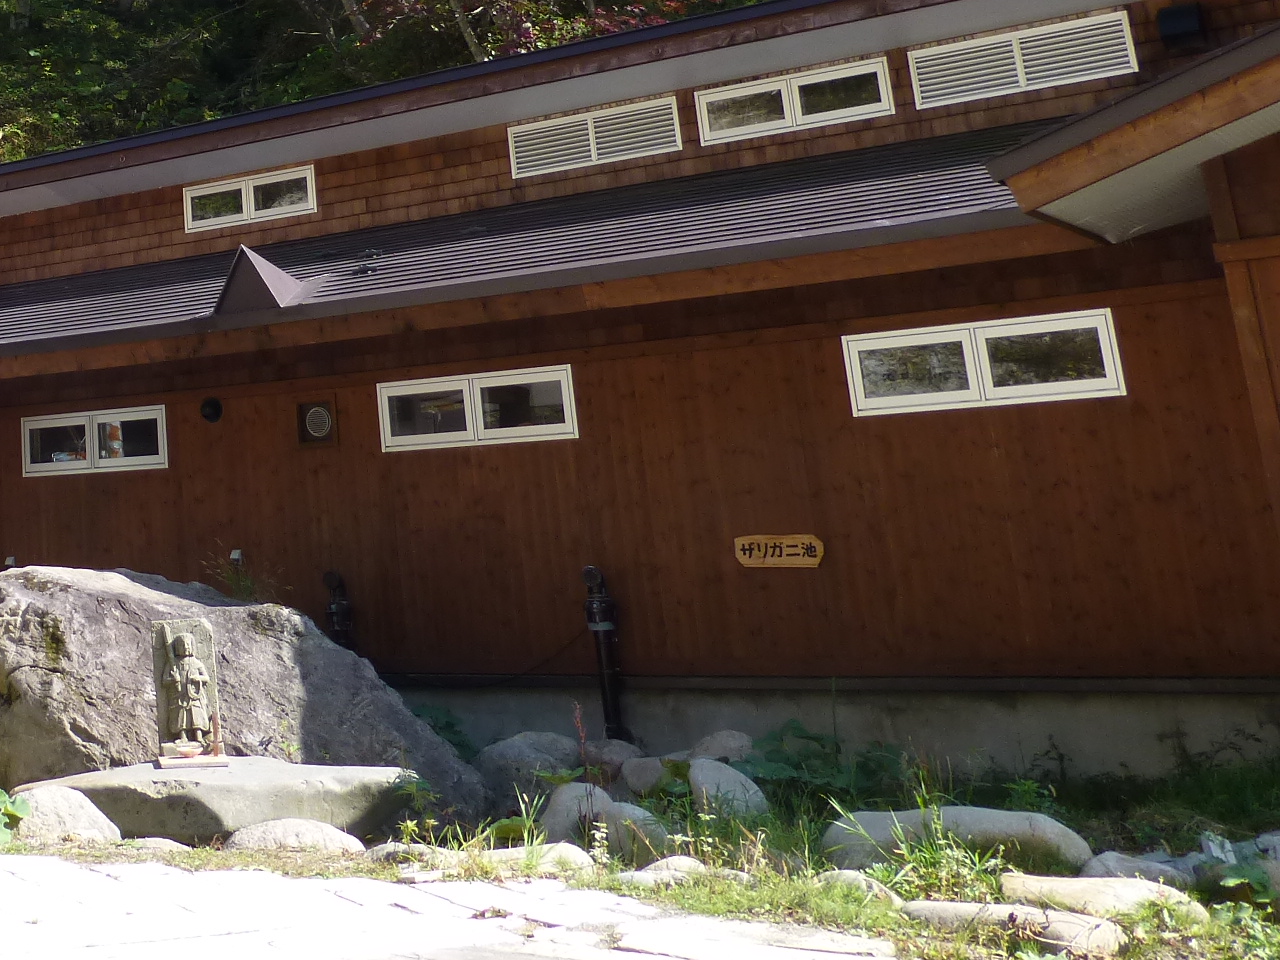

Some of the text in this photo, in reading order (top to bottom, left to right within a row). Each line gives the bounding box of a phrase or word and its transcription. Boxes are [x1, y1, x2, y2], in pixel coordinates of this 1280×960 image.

[740, 541, 818, 559] ザリガニ池
